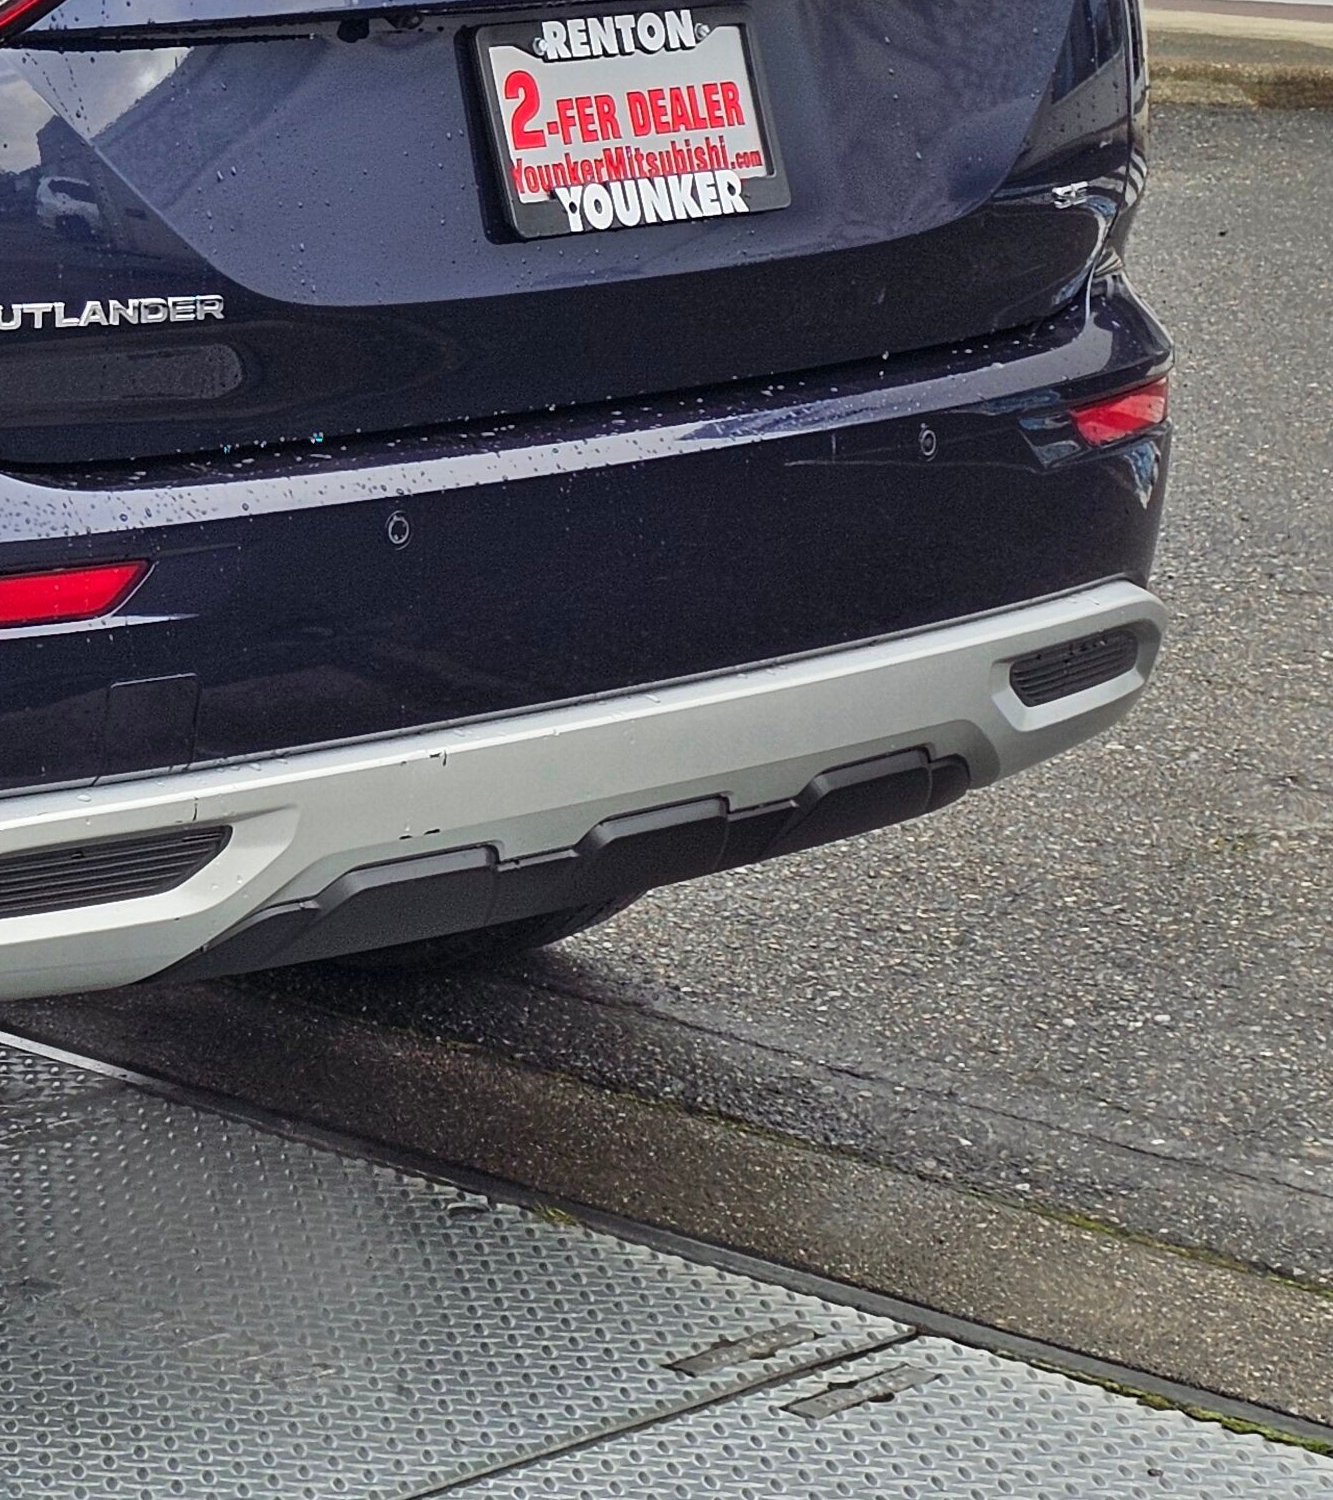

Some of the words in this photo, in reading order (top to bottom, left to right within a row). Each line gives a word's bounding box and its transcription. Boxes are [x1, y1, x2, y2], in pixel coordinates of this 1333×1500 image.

[540, 10, 696, 60] RENTON
[504, 70, 621, 150] 2-FER
[627, 81, 745, 137] DEALER
[511, 136, 763, 194] YounkerMitsubishi.com
[555, 169, 749, 232] YOUNKER
[1052, 181, 1088, 209] SE
